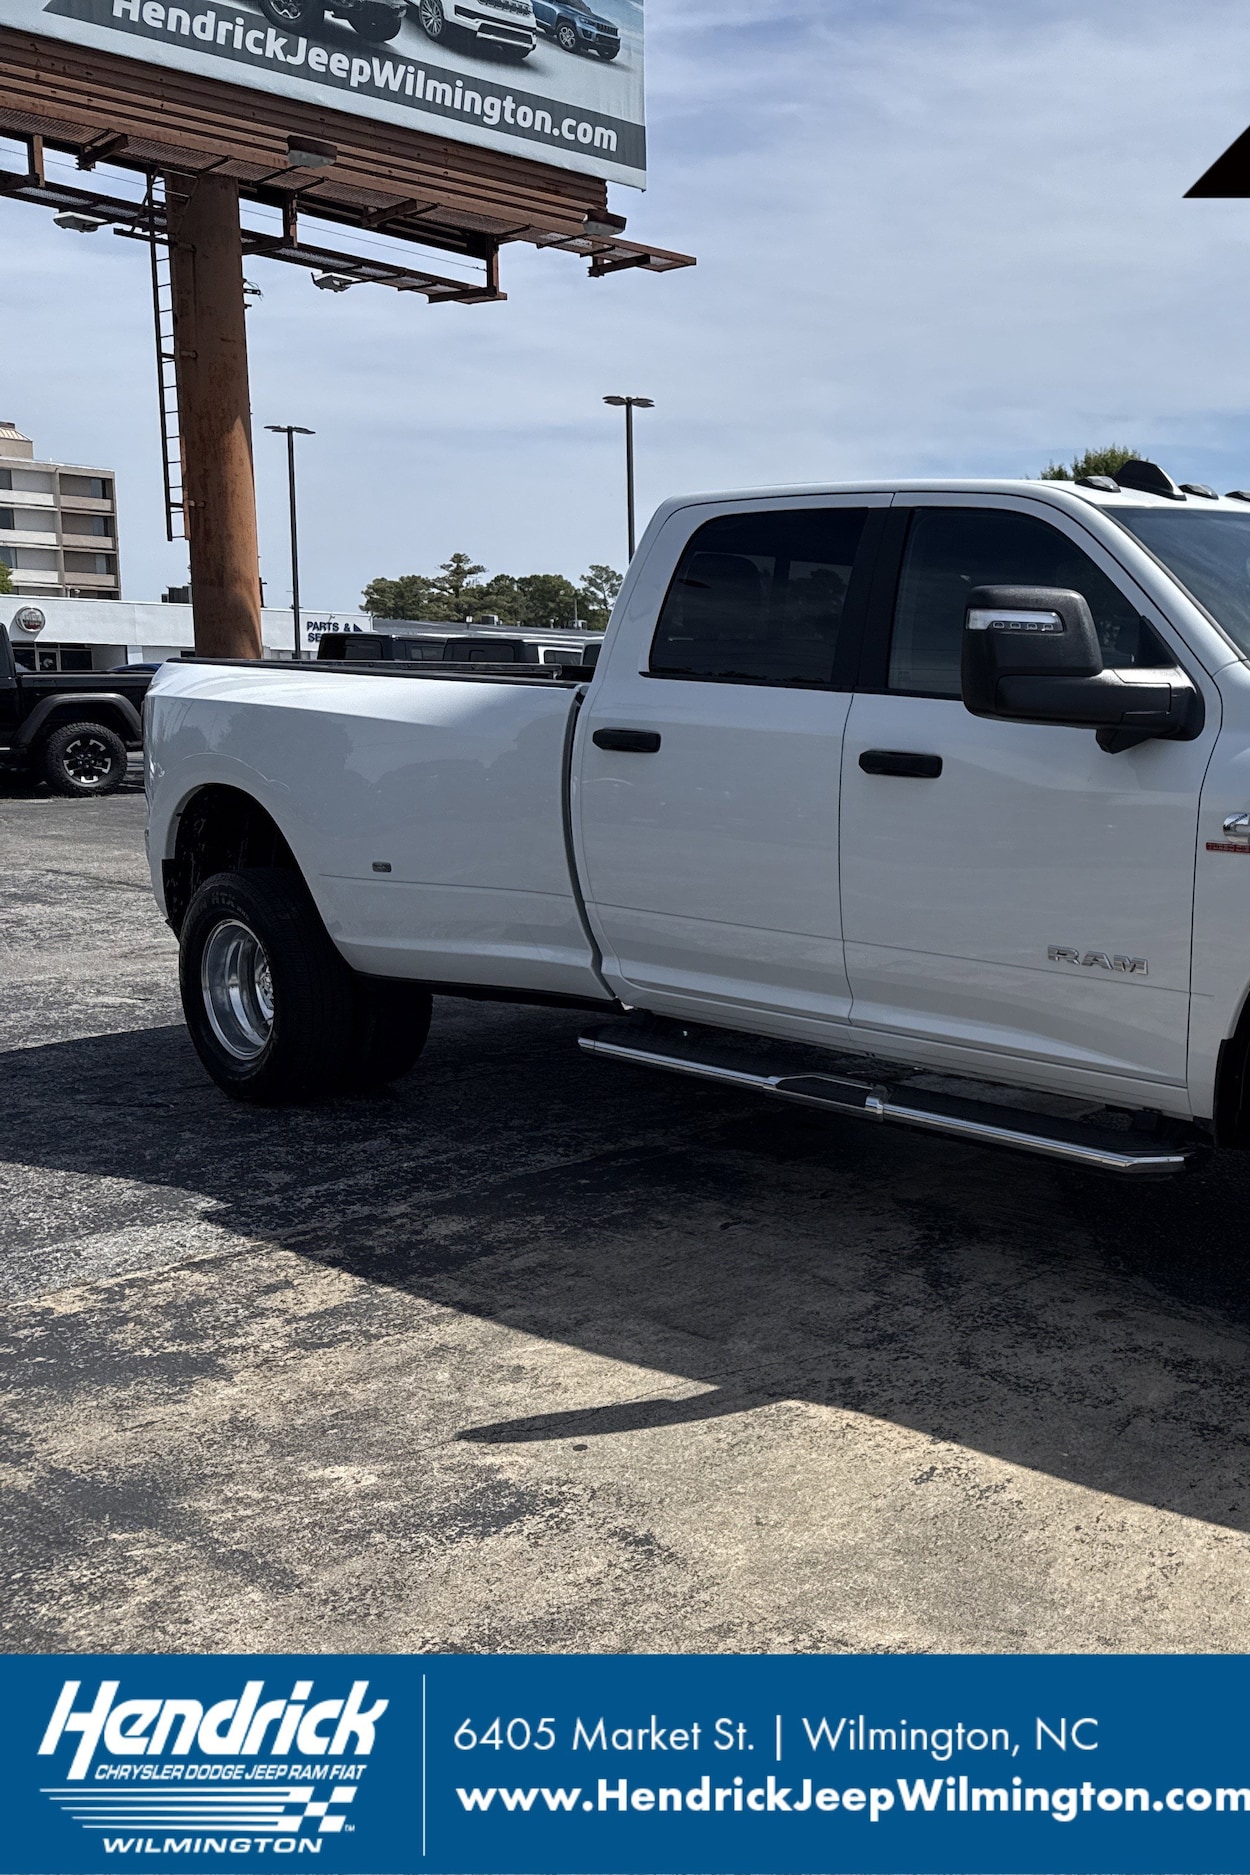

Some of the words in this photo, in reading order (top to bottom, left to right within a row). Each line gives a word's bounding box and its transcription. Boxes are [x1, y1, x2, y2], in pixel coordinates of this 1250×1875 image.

[112, 0, 618, 152] HendrickJeepWilmington.com
[306, 621, 340, 632] PARTS
[1047, 944, 1149, 975] RAM
